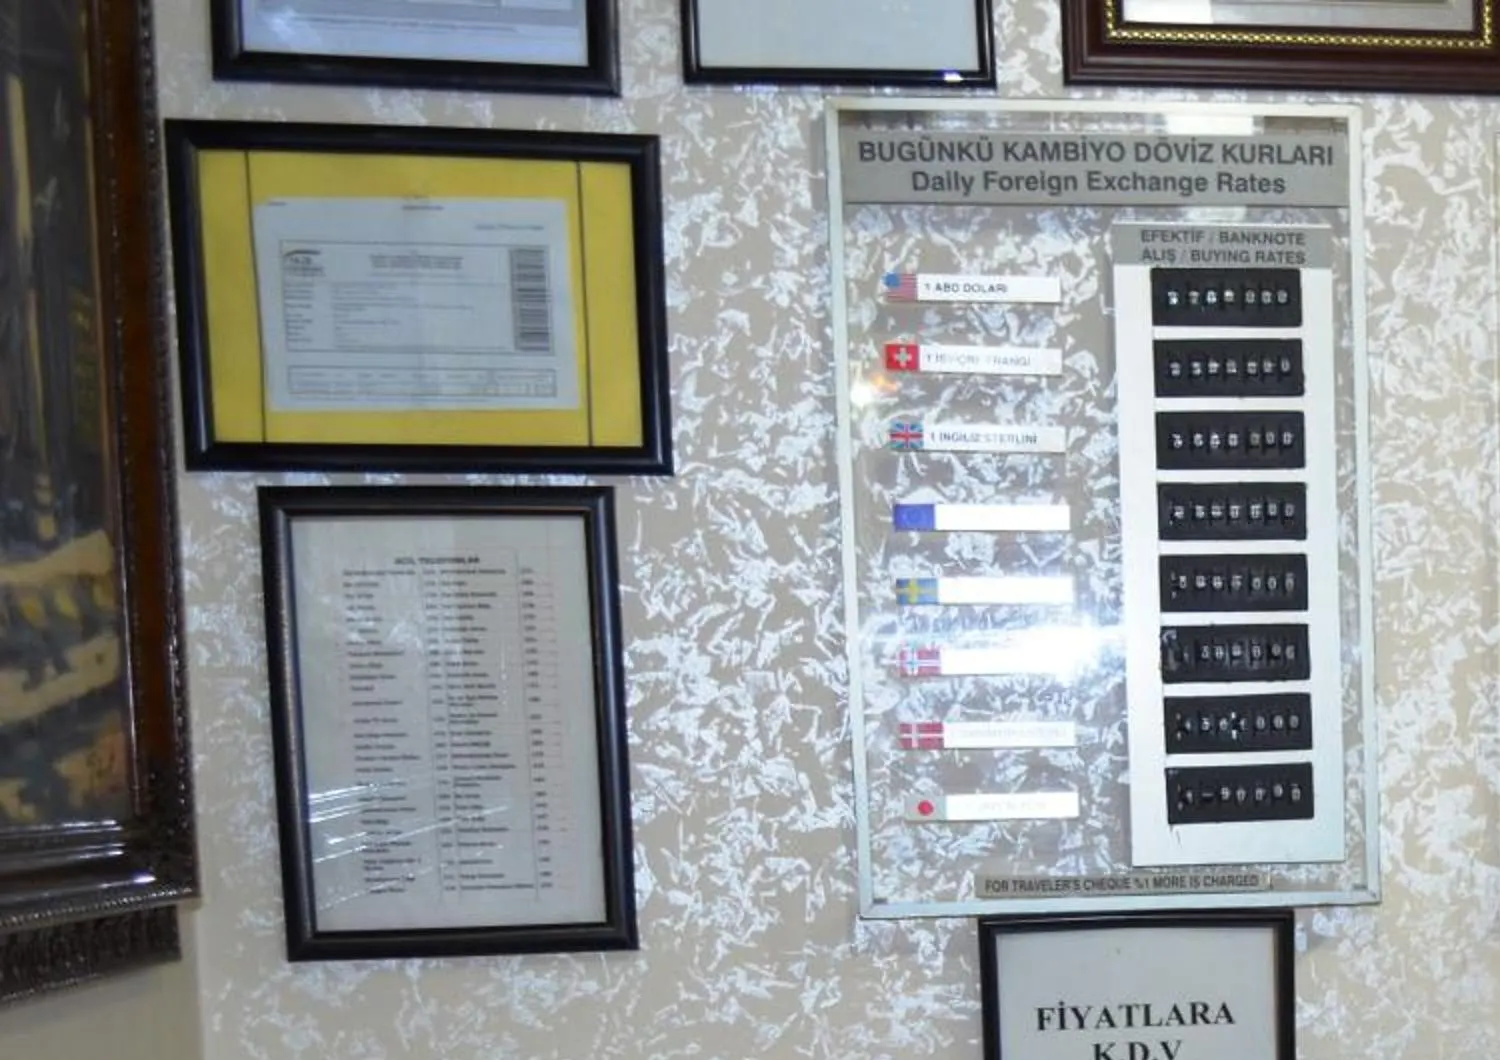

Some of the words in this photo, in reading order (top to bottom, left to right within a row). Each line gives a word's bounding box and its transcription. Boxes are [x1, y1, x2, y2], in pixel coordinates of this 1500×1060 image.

[858, 139, 994, 164] BUGÜNKÜ
[1003, 136, 1126, 164] KAMBİYO
[1134, 137, 1215, 164] DÖVİZ
[1221, 143, 1334, 166] KURLARI
[911, 172, 974, 196] Daily
[983, 171, 1078, 196] Foreign
[1087, 171, 1208, 195] Exchange
[1217, 172, 1286, 194] Rates
[1219, 230, 1306, 246] BANKNOTE
[1190, 249, 1250, 263] BUYING
[1255, 250, 1306, 265] RATES
[935, 282, 960, 293] ABD
[985, 879, 1009, 893] FOR
[1083, 877, 1132, 891] CHEQUE
[1153, 876, 1186, 889] MORE
[1189, 876, 1200, 889] IS
[1203, 874, 1260, 888] CHARGED
[1036, 1001, 1236, 1031] FİYATLARA
